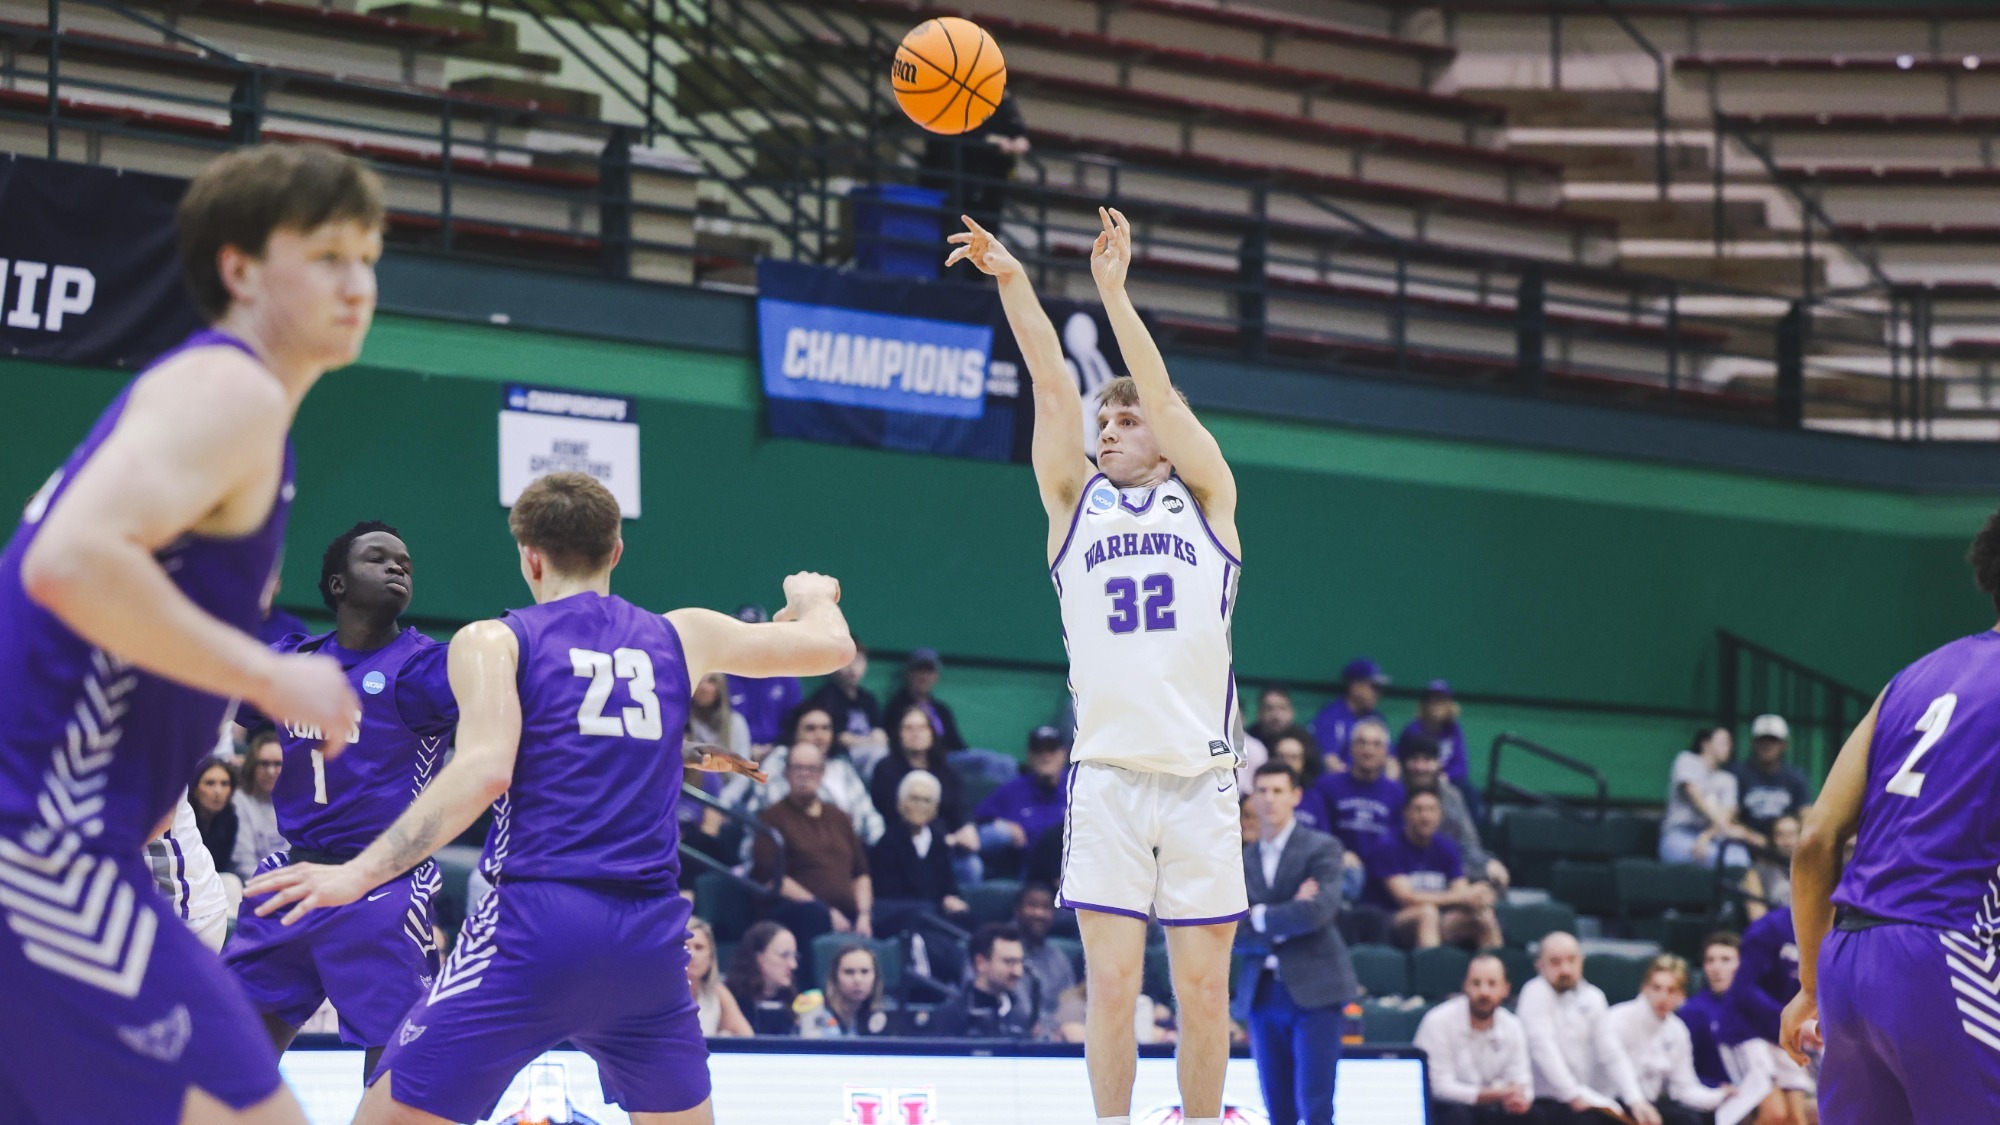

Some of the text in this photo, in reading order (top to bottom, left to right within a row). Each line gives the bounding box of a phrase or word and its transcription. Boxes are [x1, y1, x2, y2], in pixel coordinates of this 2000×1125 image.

[783, 327, 985, 399] CHAMPIONS
[1094, 494, 1113, 508] NCAA
[1084, 533, 1197, 573] WARHAWKS
[1104, 572, 1177, 635] 32
[569, 647, 662, 740] 23
[311, 748, 327, 804] 1
[1885, 692, 1957, 798] 2
